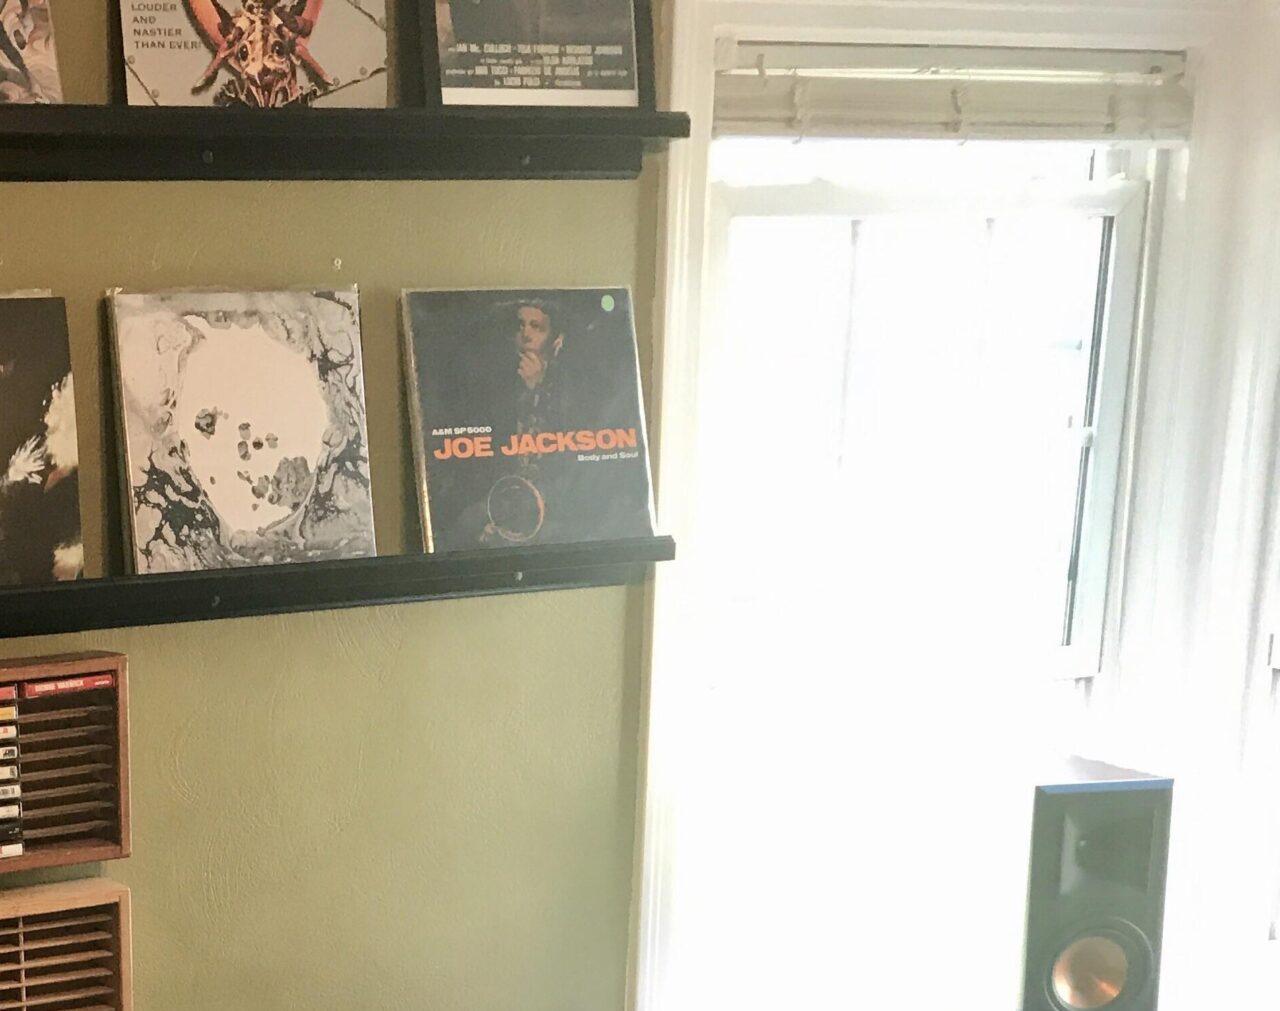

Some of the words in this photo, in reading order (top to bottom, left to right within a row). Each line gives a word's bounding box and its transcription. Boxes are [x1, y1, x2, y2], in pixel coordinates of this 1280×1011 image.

[131, 2, 177, 12] LOUDER
[132, 15, 157, 24] AND
[133, 28, 182, 37] NASTIER
[134, 40, 166, 49] THAN
[433, 436, 494, 460] JOE
[501, 428, 638, 456] JACKSON
[577, 453, 600, 462] Body
[601, 452, 618, 460] and
[619, 451, 639, 459] Soul
